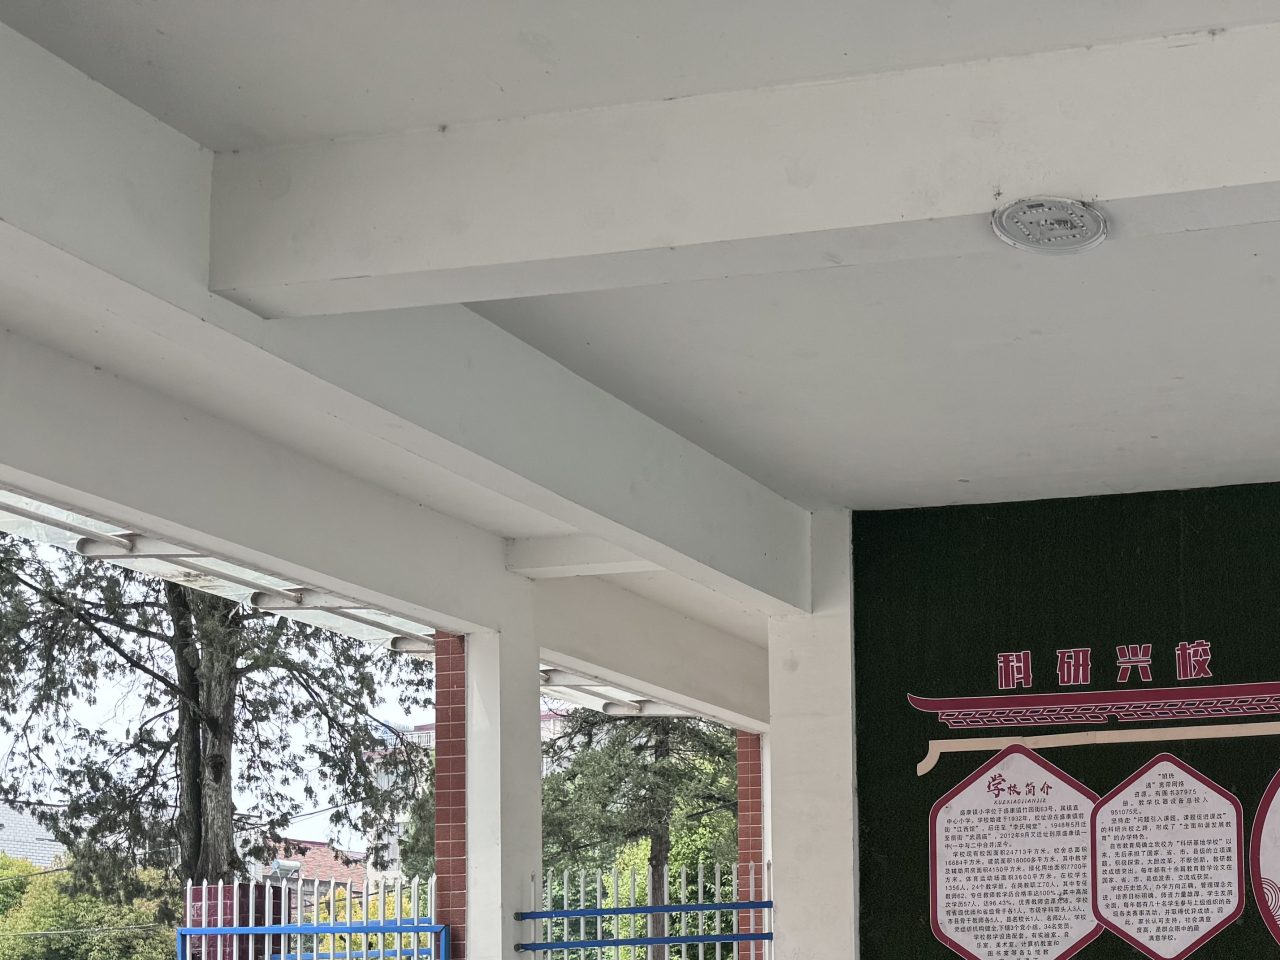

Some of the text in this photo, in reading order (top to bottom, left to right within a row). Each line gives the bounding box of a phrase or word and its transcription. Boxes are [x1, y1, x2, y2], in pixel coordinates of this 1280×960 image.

[998, 640, 1212, 689] 科研兴校
[987, 773, 1052, 798] 学校简介
